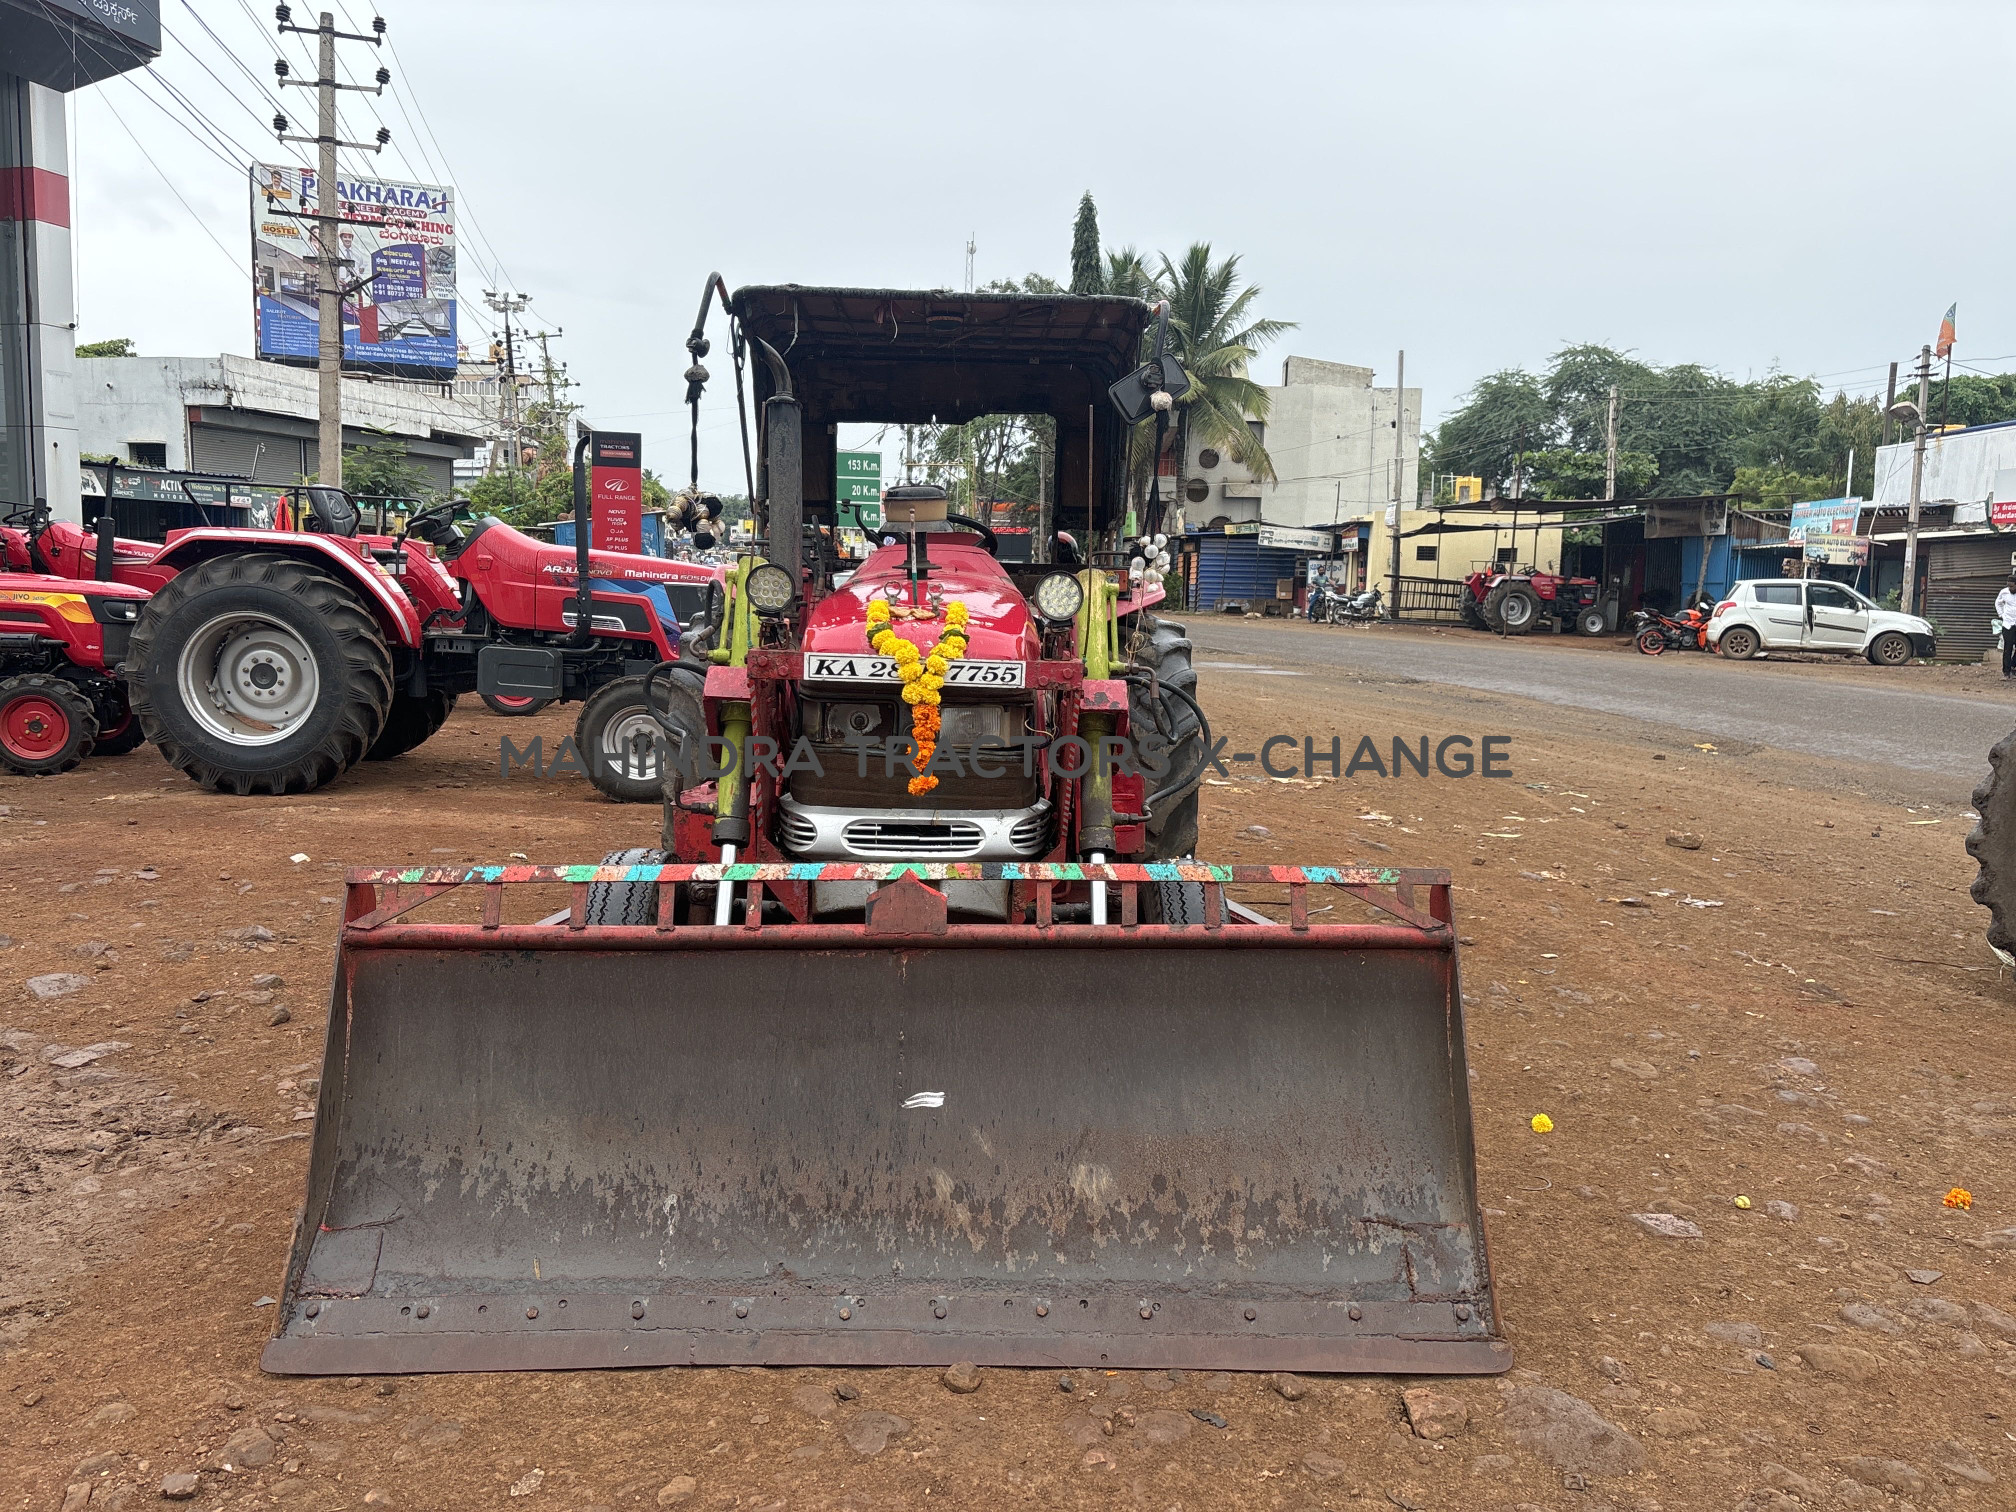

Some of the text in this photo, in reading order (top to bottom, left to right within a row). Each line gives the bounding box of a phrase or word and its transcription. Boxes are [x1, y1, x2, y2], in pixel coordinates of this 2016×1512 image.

[302, 177, 447, 213] PAKHARAJ
[263, 225, 297, 235] HOSTEL
[848, 459, 880, 471] 153 K.m.
[191, 482, 213, 492] Welcome
[851, 484, 880, 497] 20 K.m.
[863, 510, 880, 522] K.m.
[1813, 507, 1826, 517] AUTO
[1826, 538, 1839, 546] AUTO
[133, 550, 155, 558] YUVO
[542, 565, 581, 574] ARJU
[624, 569, 679, 580] Mahindra
[12, 593, 30, 601] JIVO
[812, 659, 859, 677] KA
[949, 664, 1020, 684] 7755
